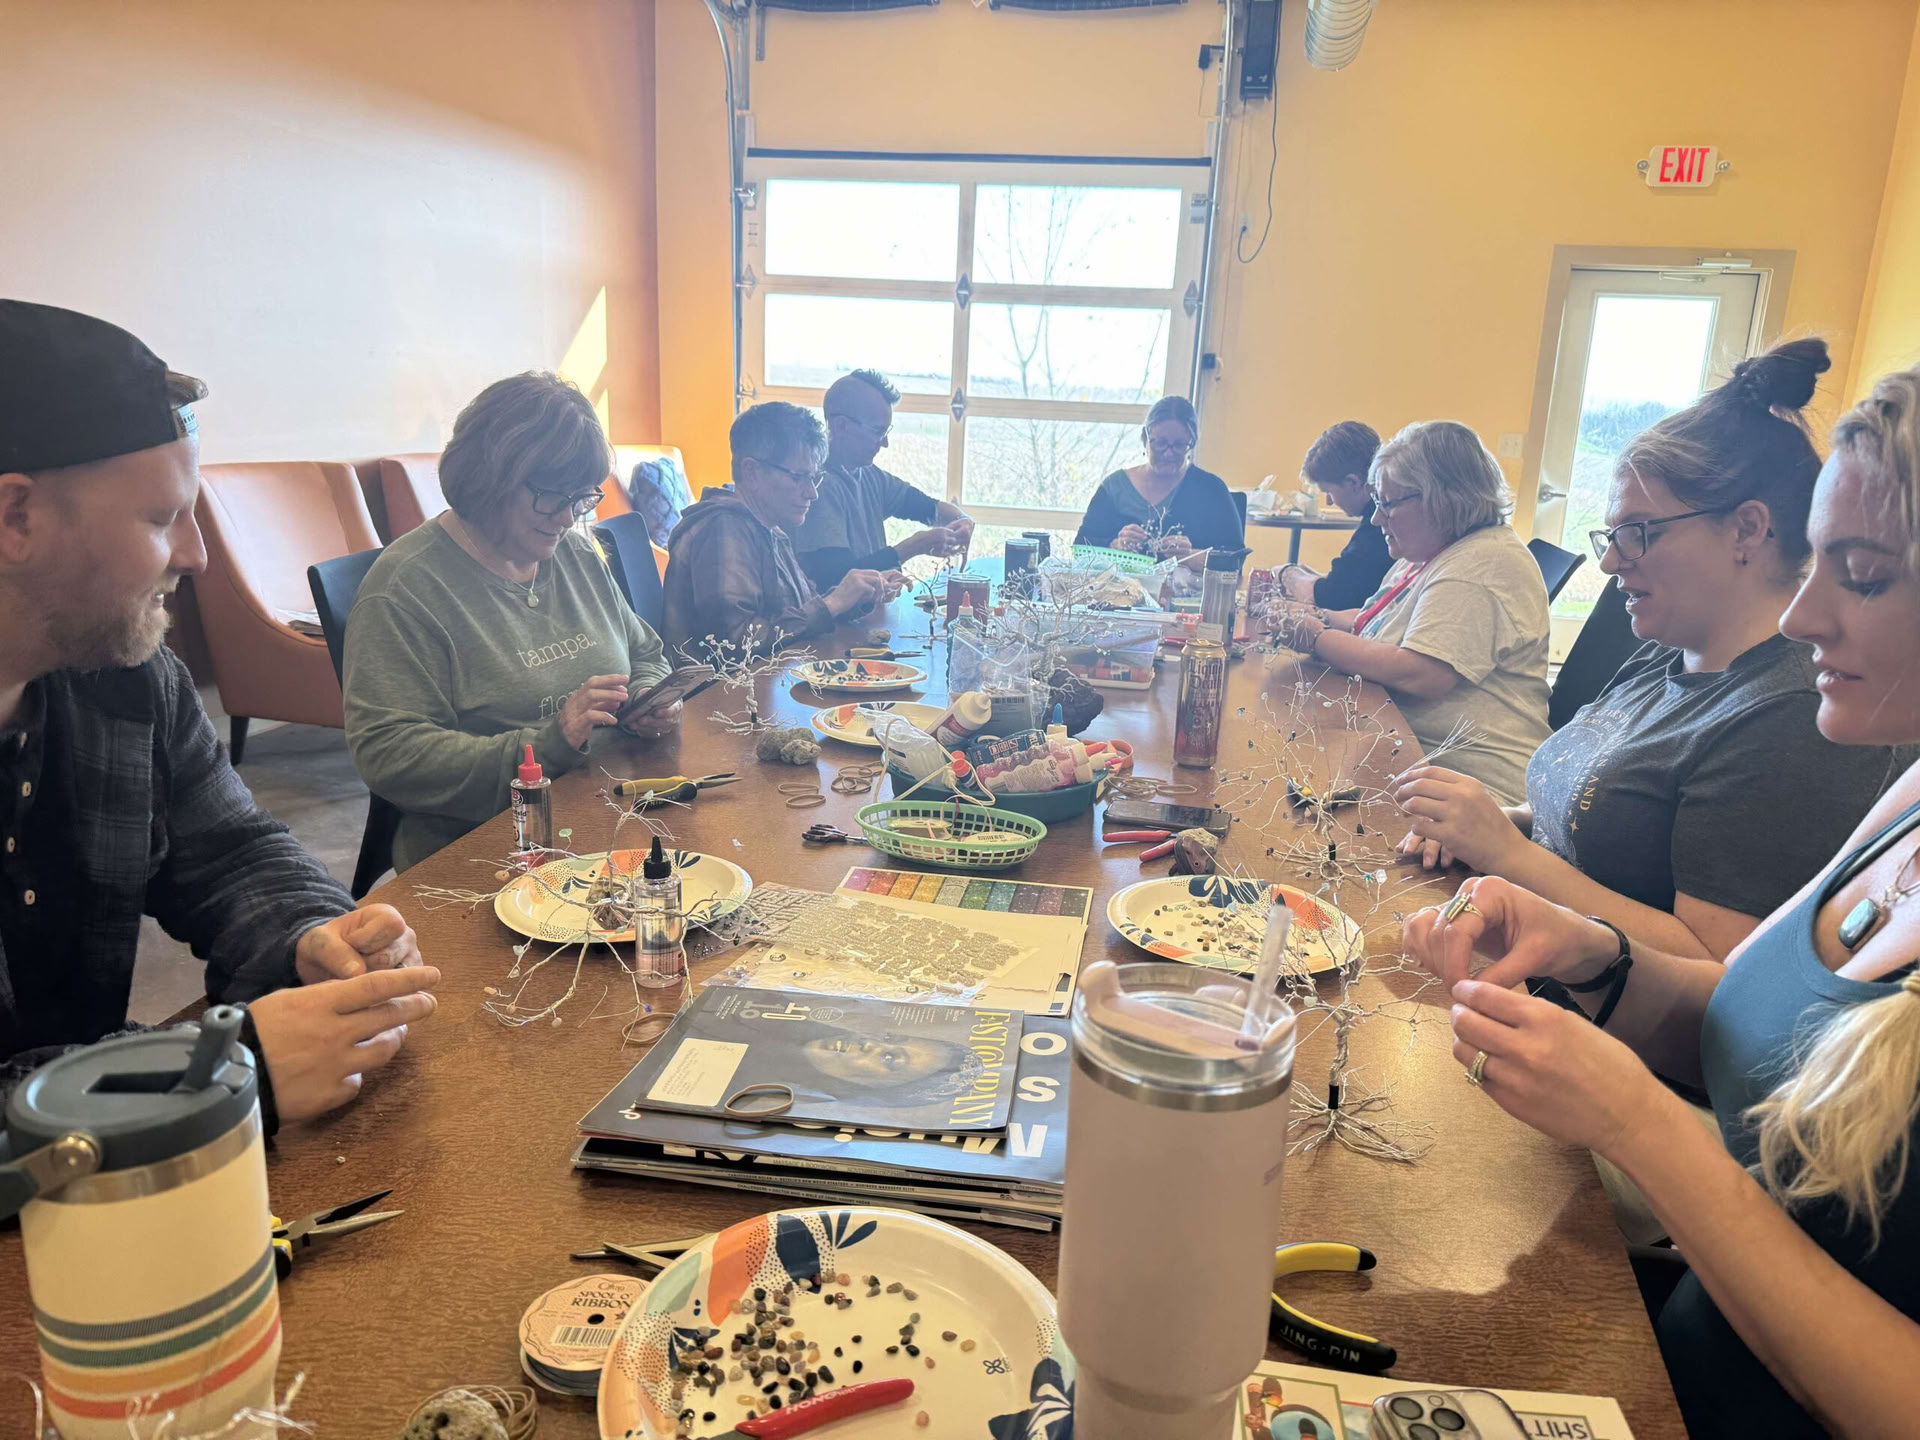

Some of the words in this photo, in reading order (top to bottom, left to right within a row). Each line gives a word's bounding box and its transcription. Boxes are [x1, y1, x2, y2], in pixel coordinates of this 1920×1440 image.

[1659, 147, 1710, 183] EXIT
[1579, 775, 1599, 811] AND
[571, 1297, 631, 1309] RIBBON
[577, 1290, 615, 1299] SPOOL
[1528, 1419, 1588, 1440] SMIT
